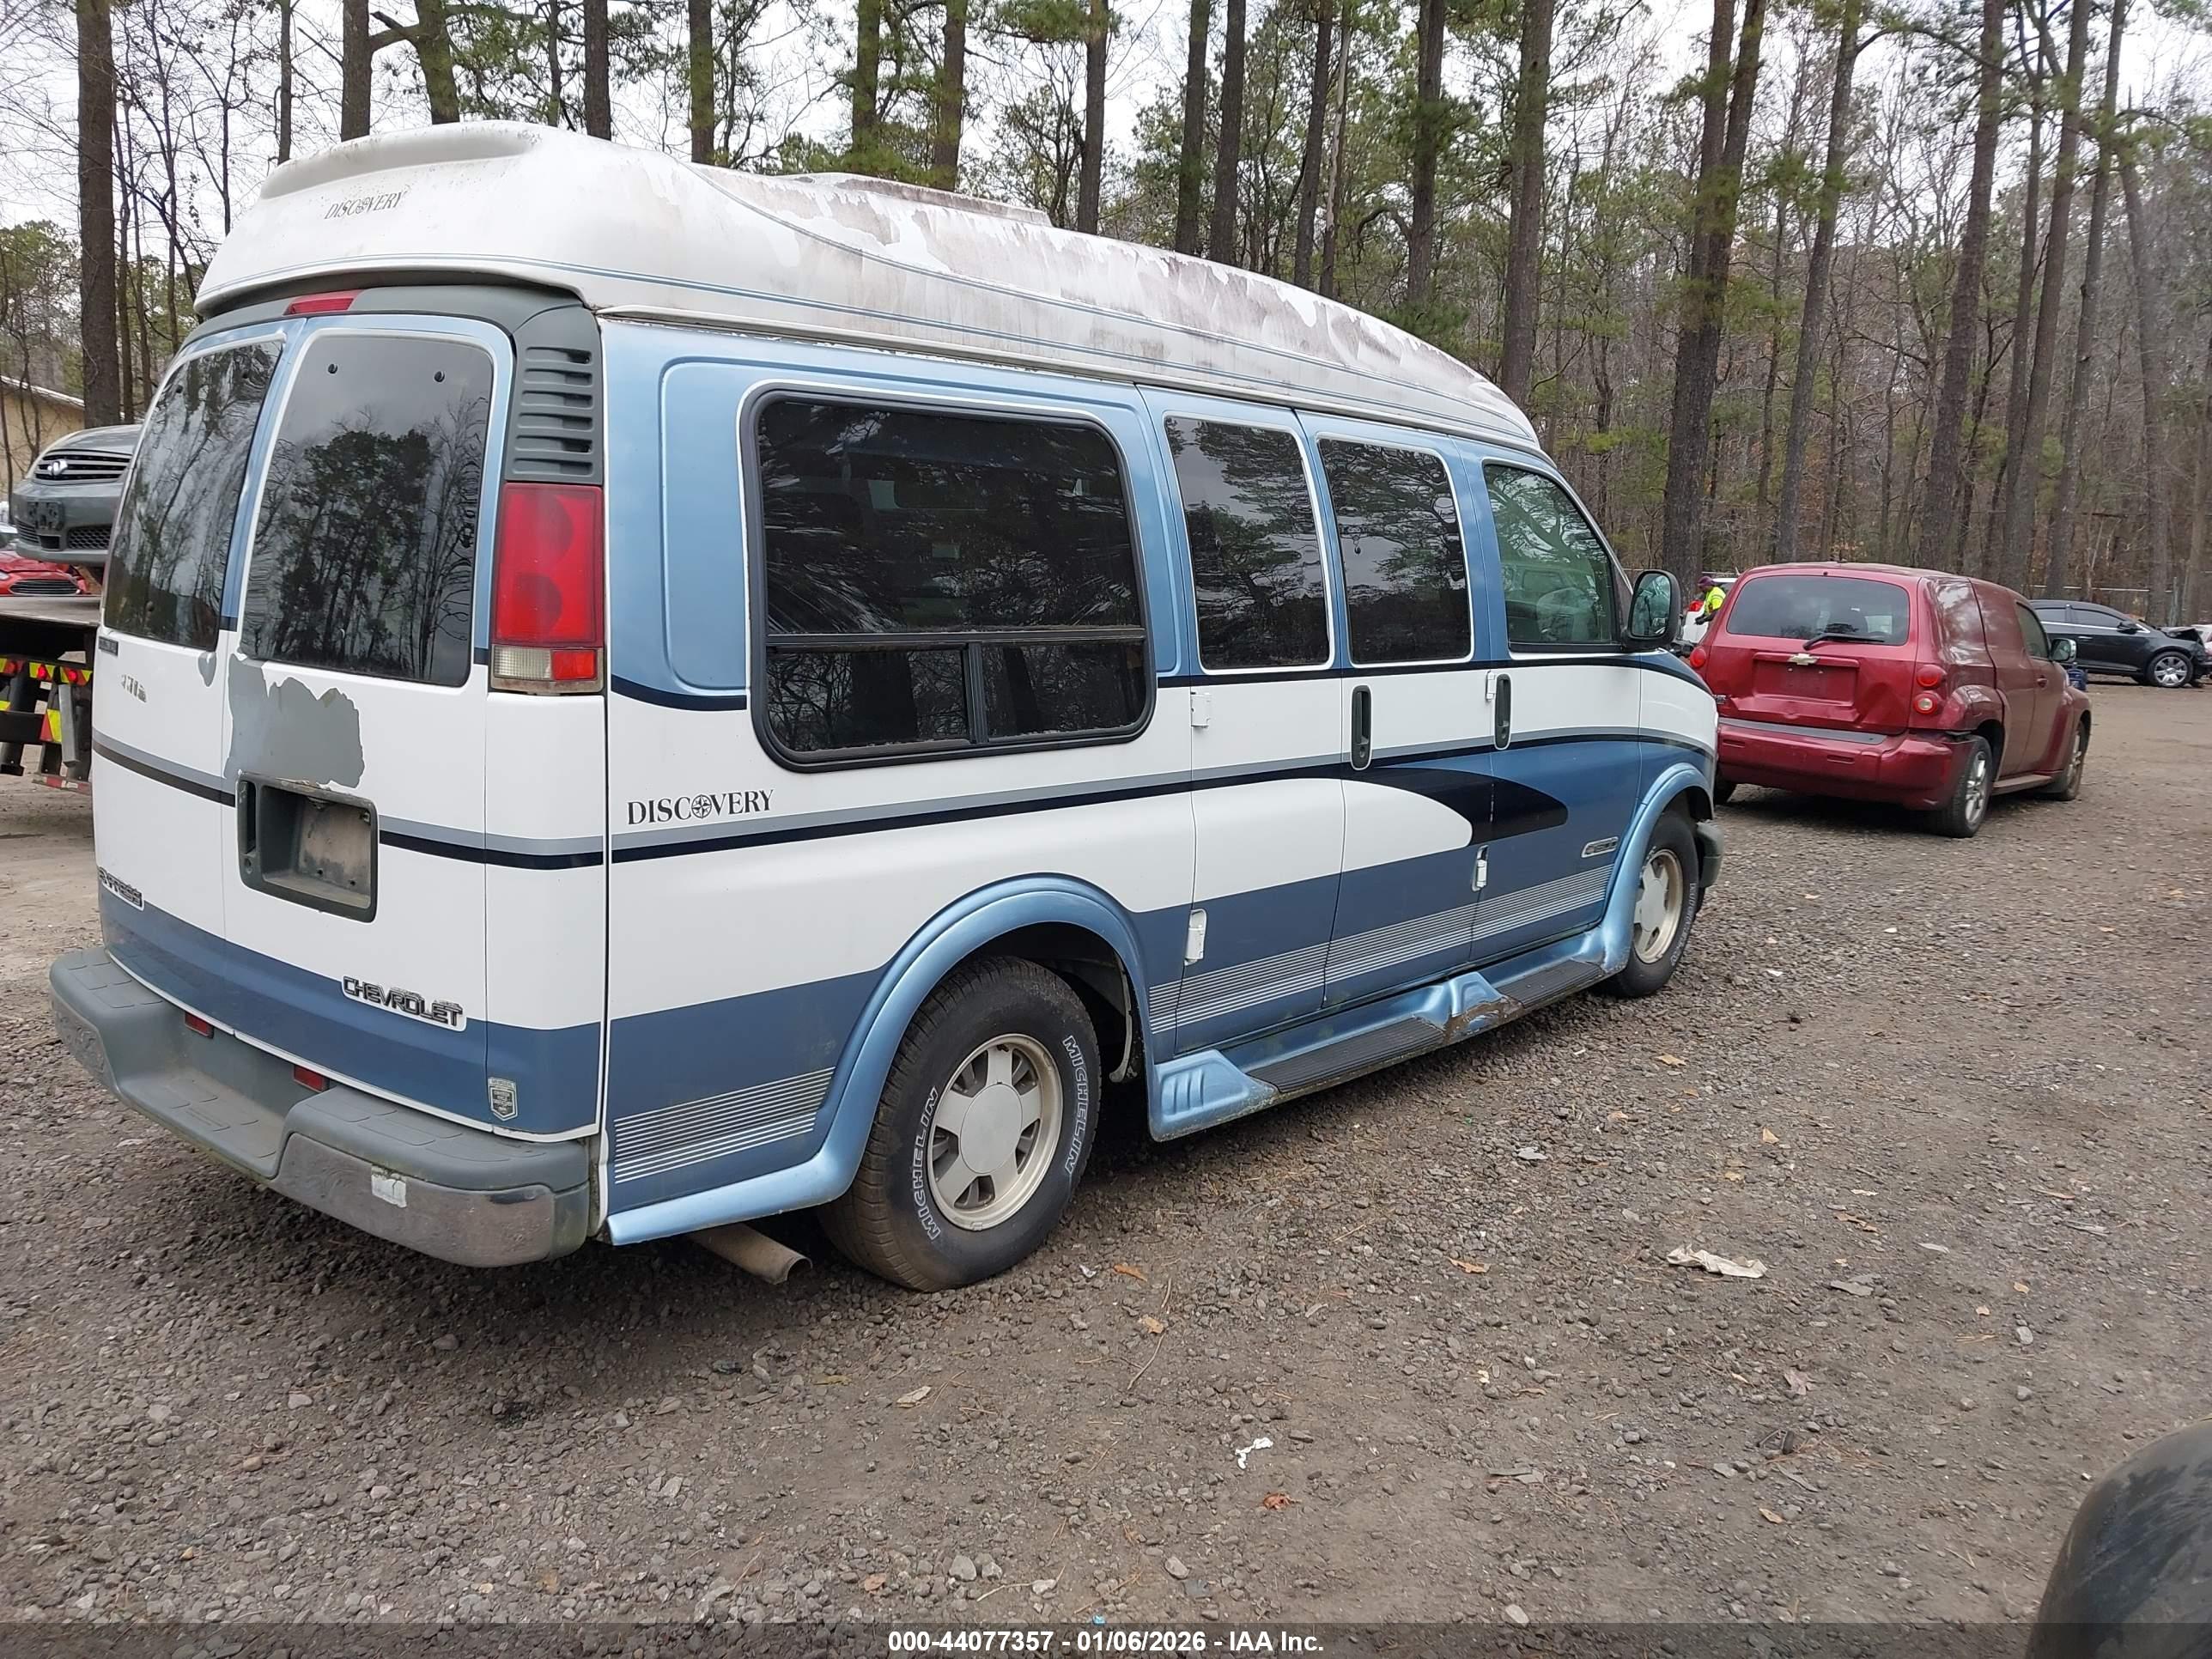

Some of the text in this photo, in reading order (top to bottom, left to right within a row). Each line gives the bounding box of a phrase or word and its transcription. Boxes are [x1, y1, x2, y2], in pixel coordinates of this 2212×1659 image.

[324, 191, 408, 219] DISCOVERY
[628, 789, 774, 825] DISCOVERY
[343, 975, 464, 1027] CHEVROLET
[1062, 1035, 1089, 1174] MICHELIN
[912, 1086, 941, 1241] MICHELIN
